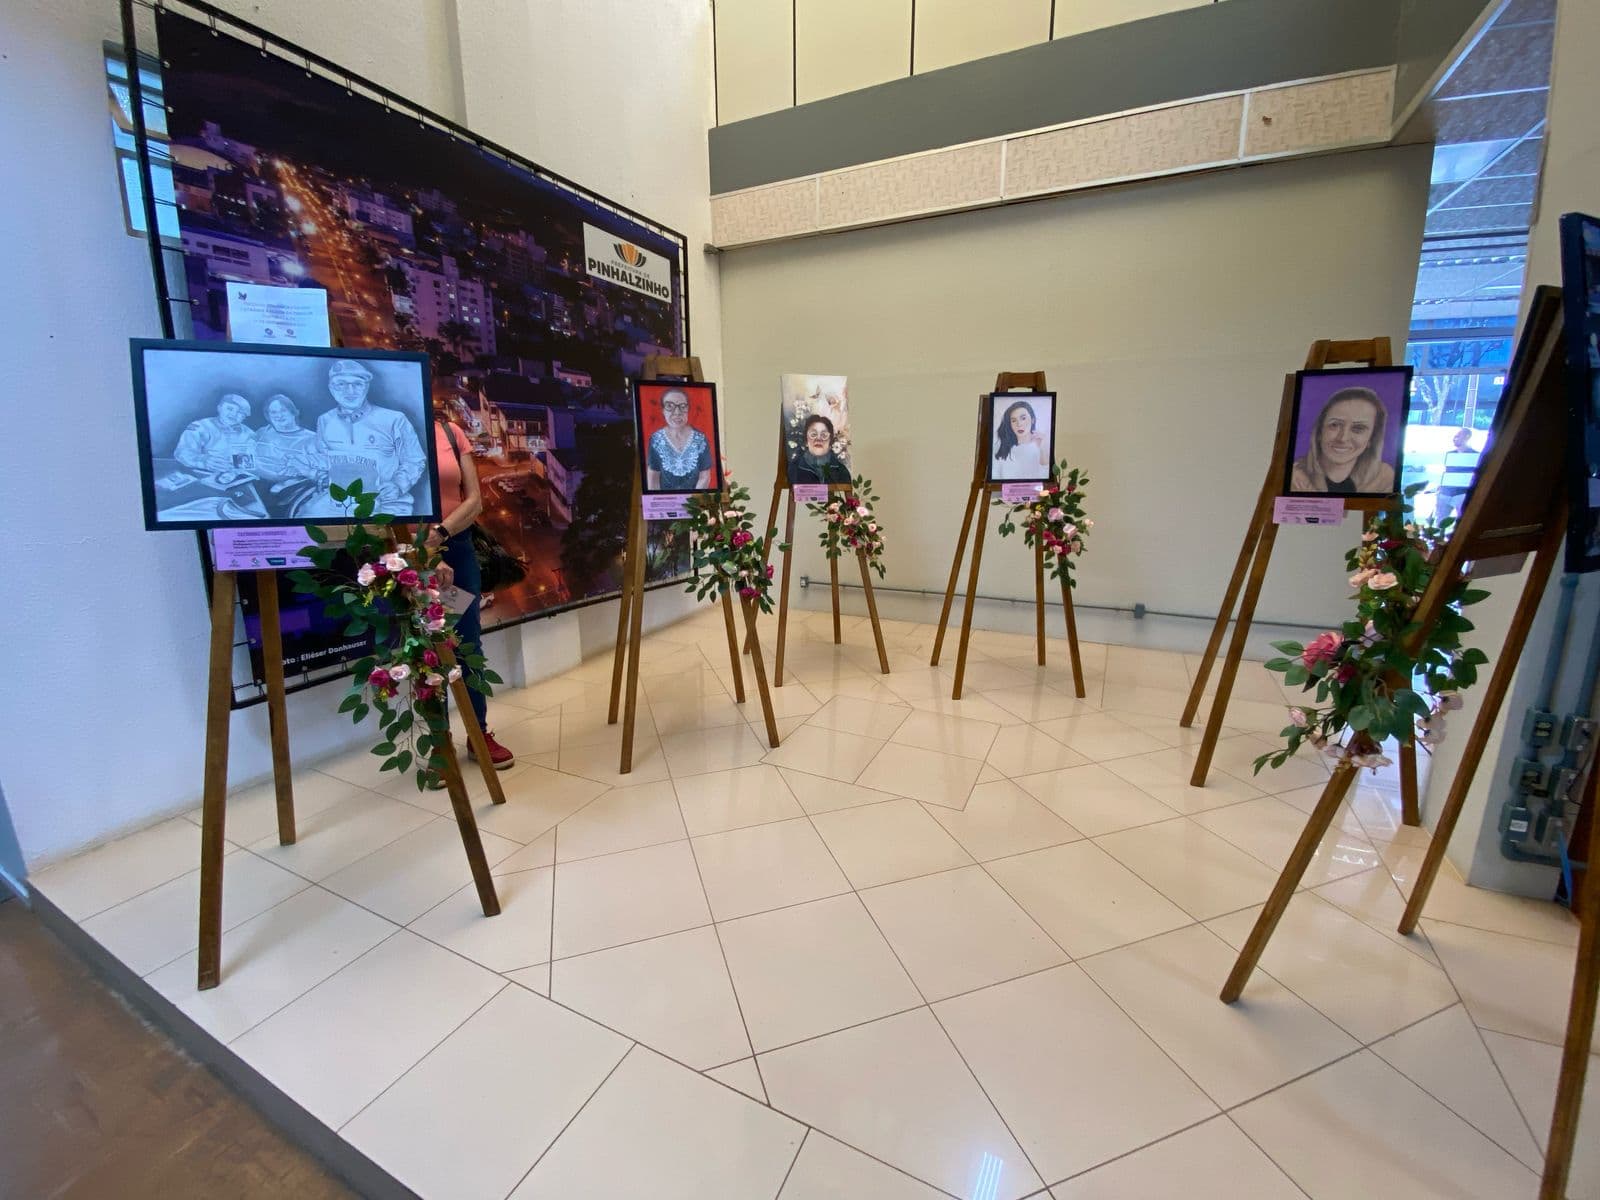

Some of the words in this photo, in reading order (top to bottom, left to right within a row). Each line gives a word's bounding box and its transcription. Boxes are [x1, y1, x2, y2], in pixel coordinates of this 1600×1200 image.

[588, 257, 670, 299] PINHALZINHO
[281, 657, 296, 666] oto
[300, 649, 327, 661] Eliéser
